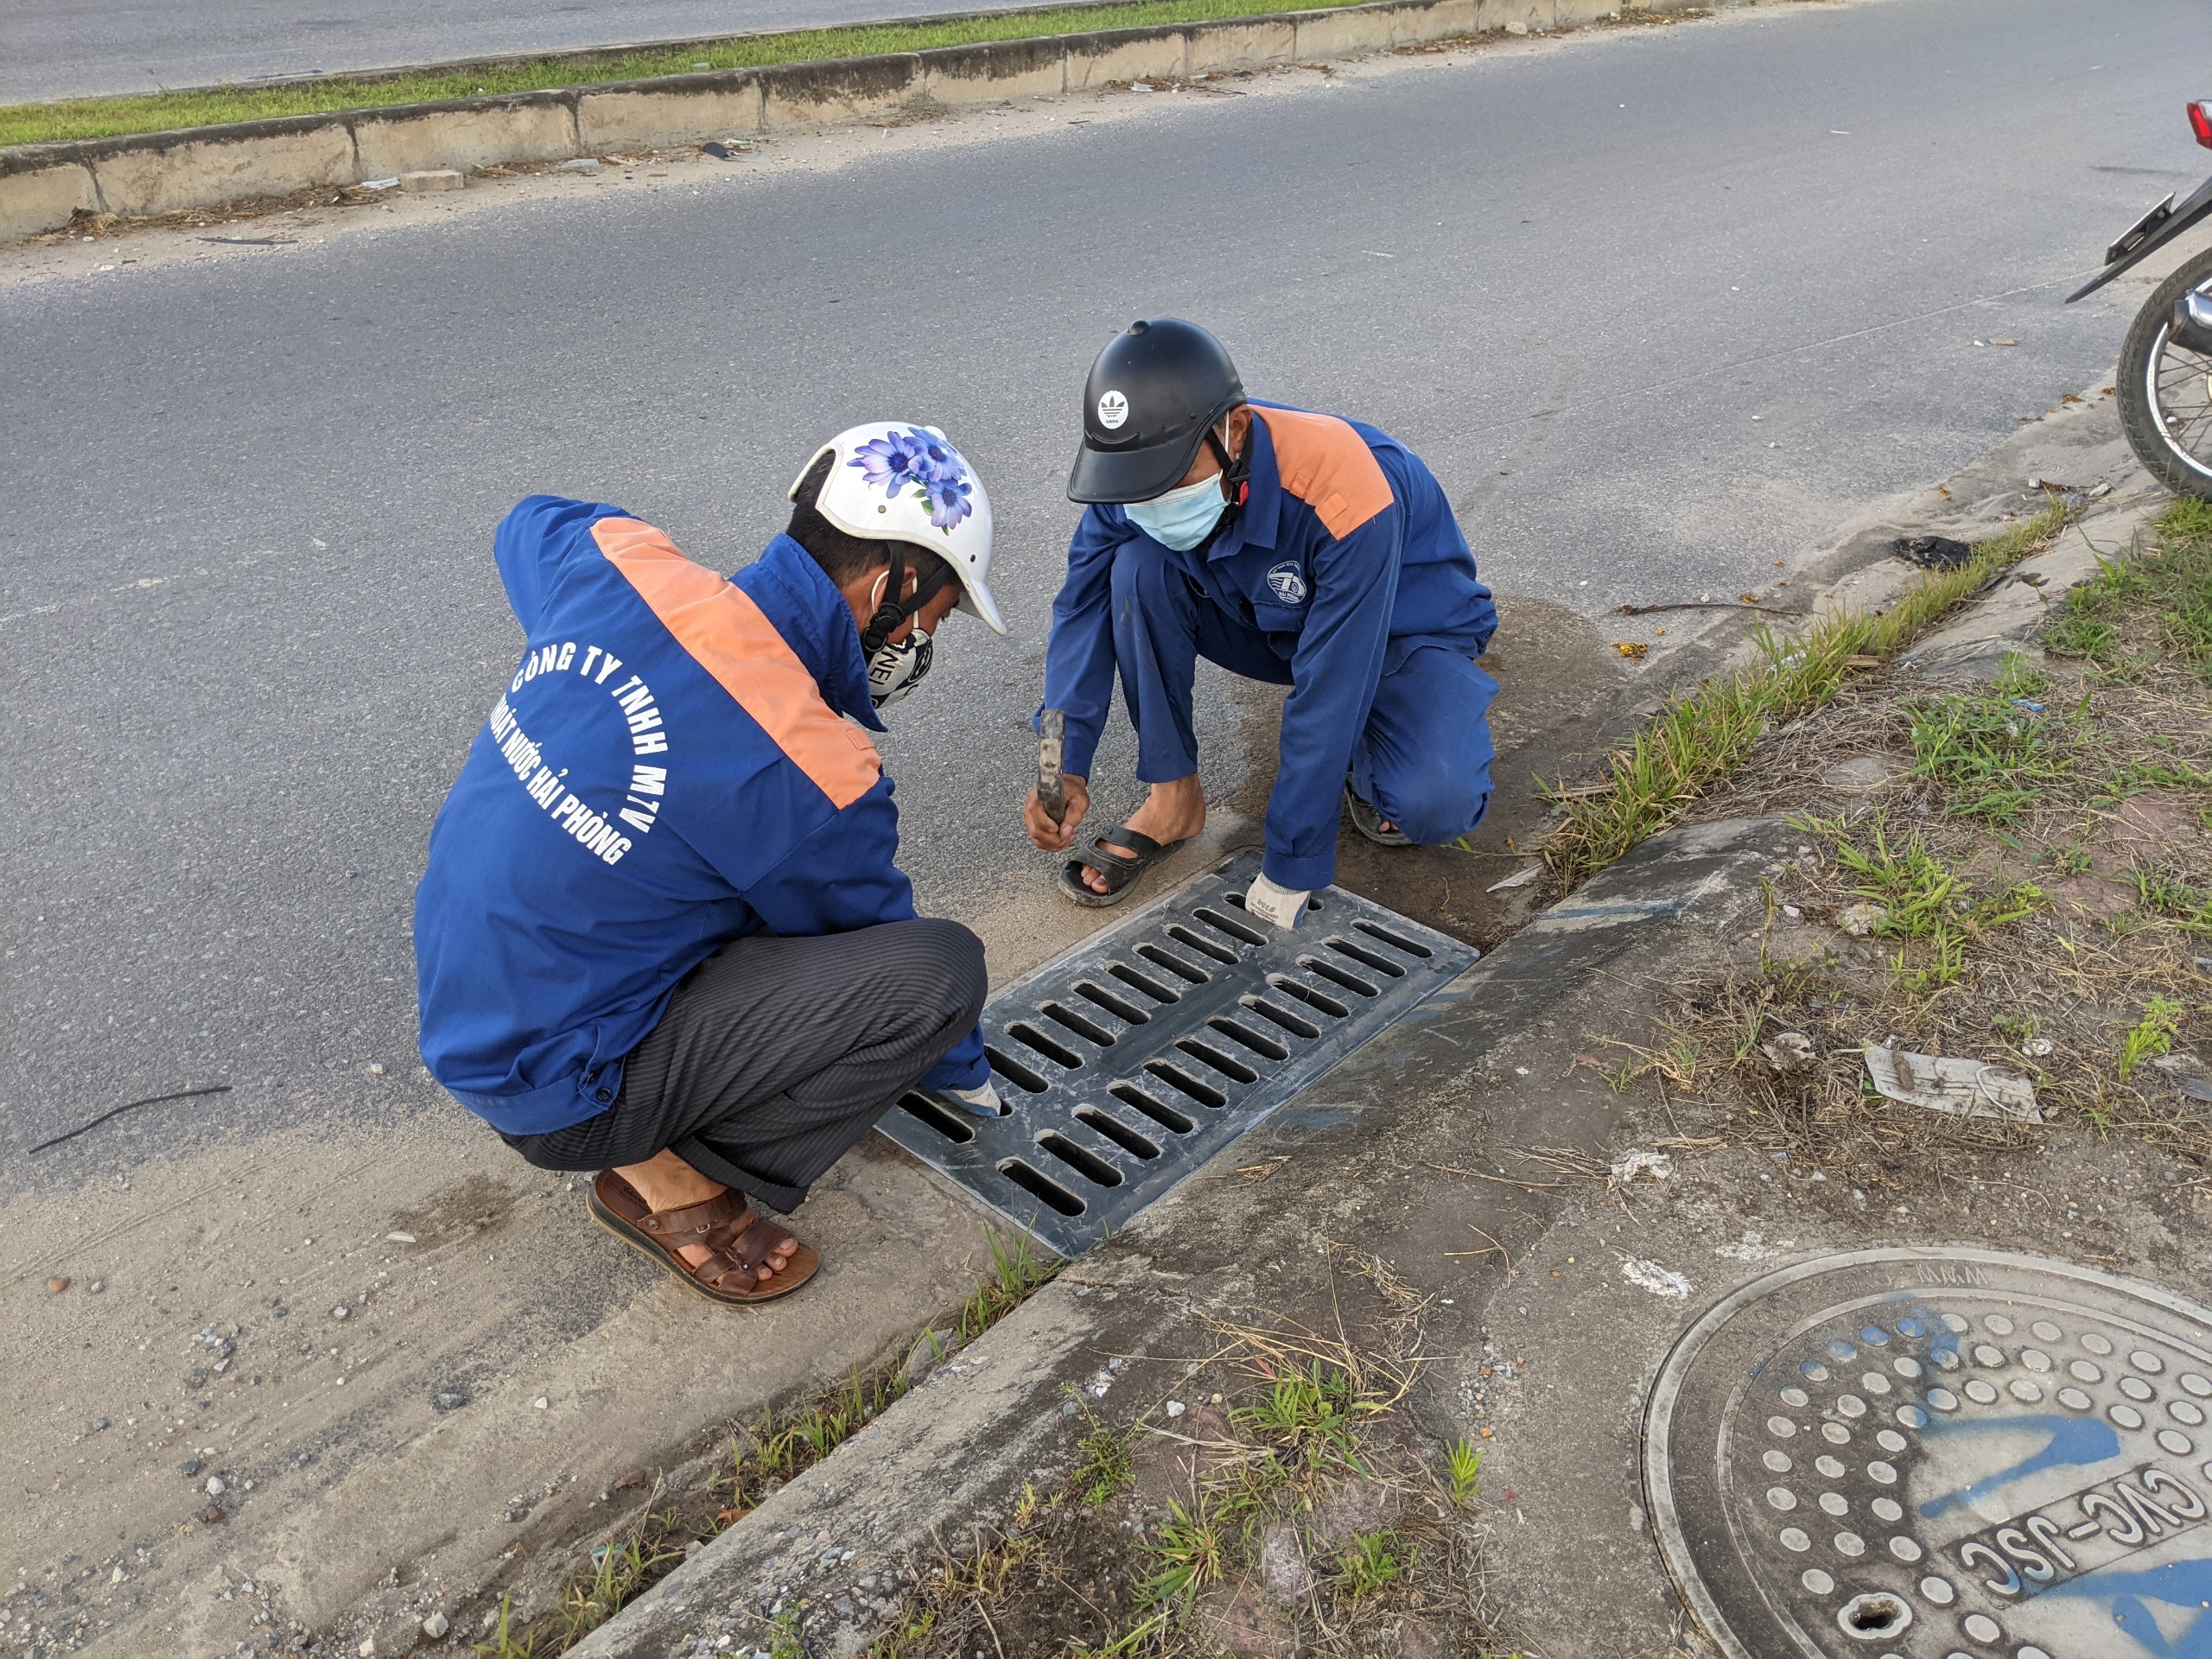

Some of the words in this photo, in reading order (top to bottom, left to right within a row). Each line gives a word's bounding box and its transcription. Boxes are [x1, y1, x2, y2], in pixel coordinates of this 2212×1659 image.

[512, 642, 576, 692] CÔNG
[580, 645, 623, 684] TY
[611, 675, 668, 755] TNHH
[501, 728, 543, 781] NƯỚC
[526, 766, 568, 810] HẢI
[550, 794, 632, 865] PHÒNG
[619, 765, 667, 834] MTV
[1961, 1469, 2206, 1596] CVC-JSC
